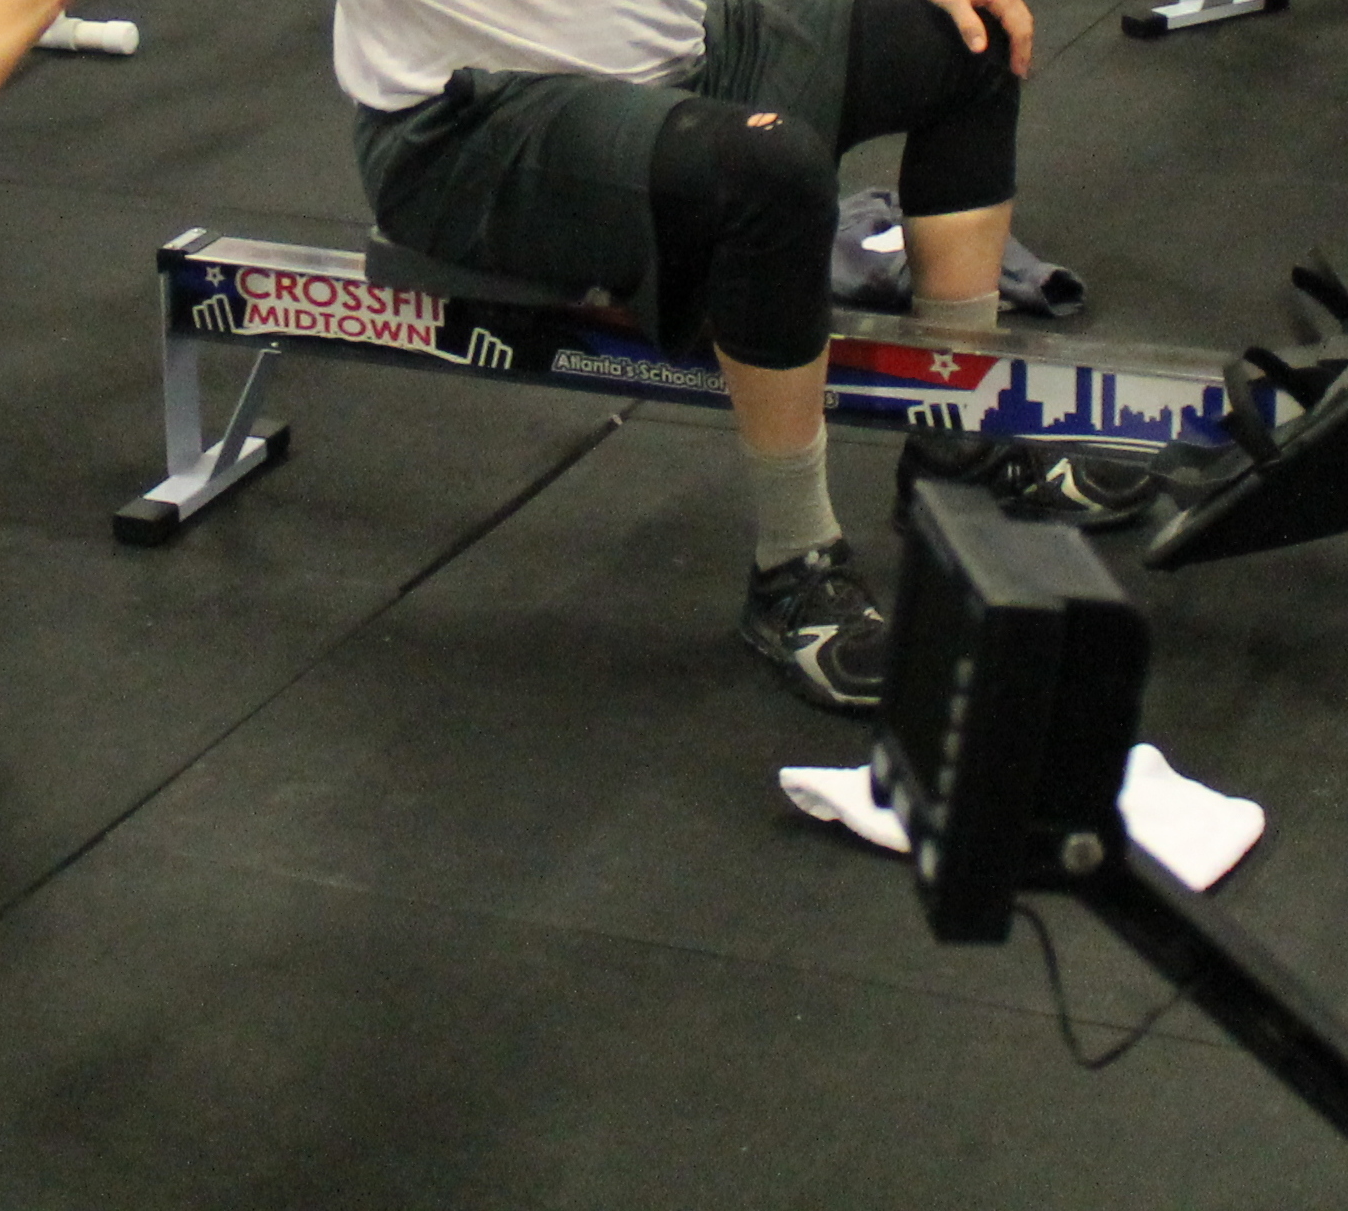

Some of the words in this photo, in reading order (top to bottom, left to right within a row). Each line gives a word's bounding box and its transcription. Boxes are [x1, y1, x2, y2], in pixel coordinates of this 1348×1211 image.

[240, 268, 444, 322] CROSSFIT
[248, 304, 432, 346] MIDTOWN
[556, 352, 635, 378] Atlanta's
[639, 363, 702, 388] School
